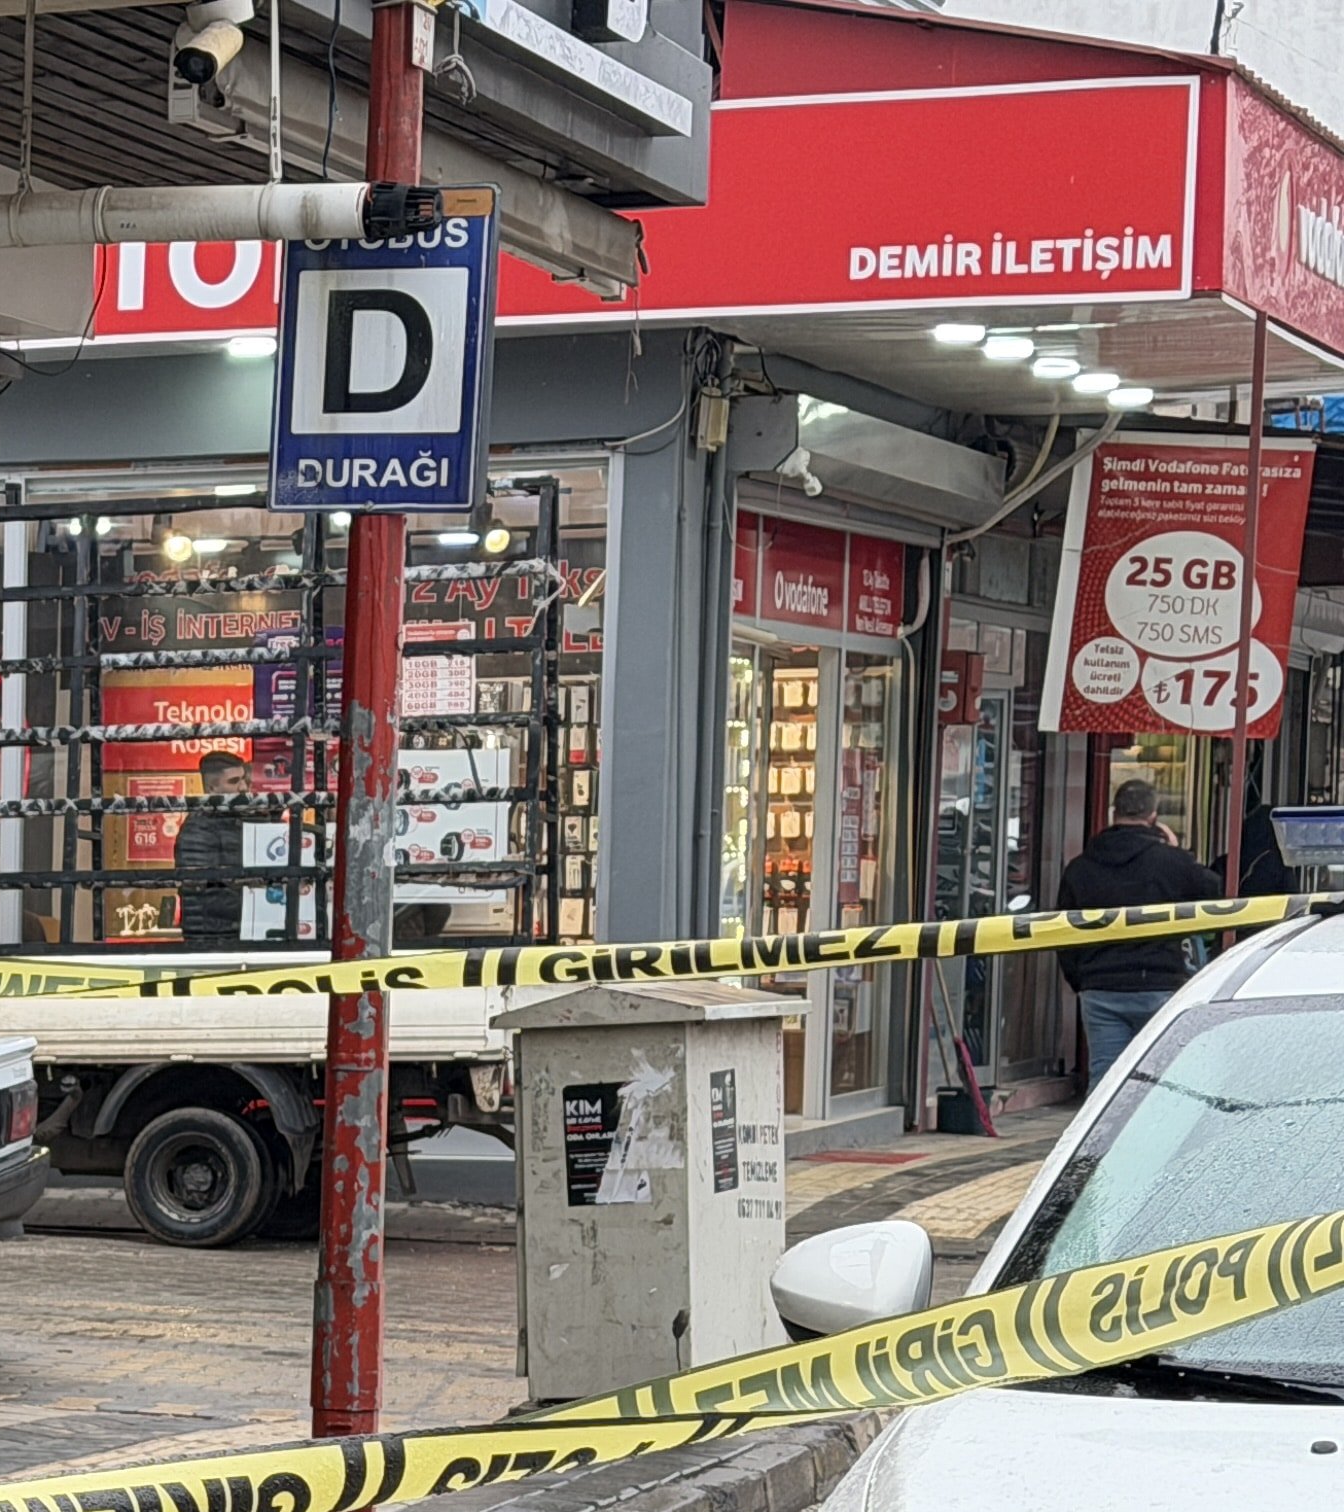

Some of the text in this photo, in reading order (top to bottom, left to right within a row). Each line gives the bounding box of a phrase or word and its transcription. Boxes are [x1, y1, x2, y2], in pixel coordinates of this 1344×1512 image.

[850, 226, 1172, 280] DEMİR İLETİŞİM
[322, 289, 434, 414] D
[297, 451, 450, 489] DURAĞI
[1103, 456, 1302, 478] Şimdi Vodafone Fatrasıza
[1101, 477, 1170, 493] gelmenin
[1173, 481, 1202, 494] tam
[1125, 556, 1237, 591] 25 GB
[785, 573, 829, 617] vodafone
[1147, 594, 1220, 617] 750 DK
[1137, 622, 1223, 645] 750 SMS
